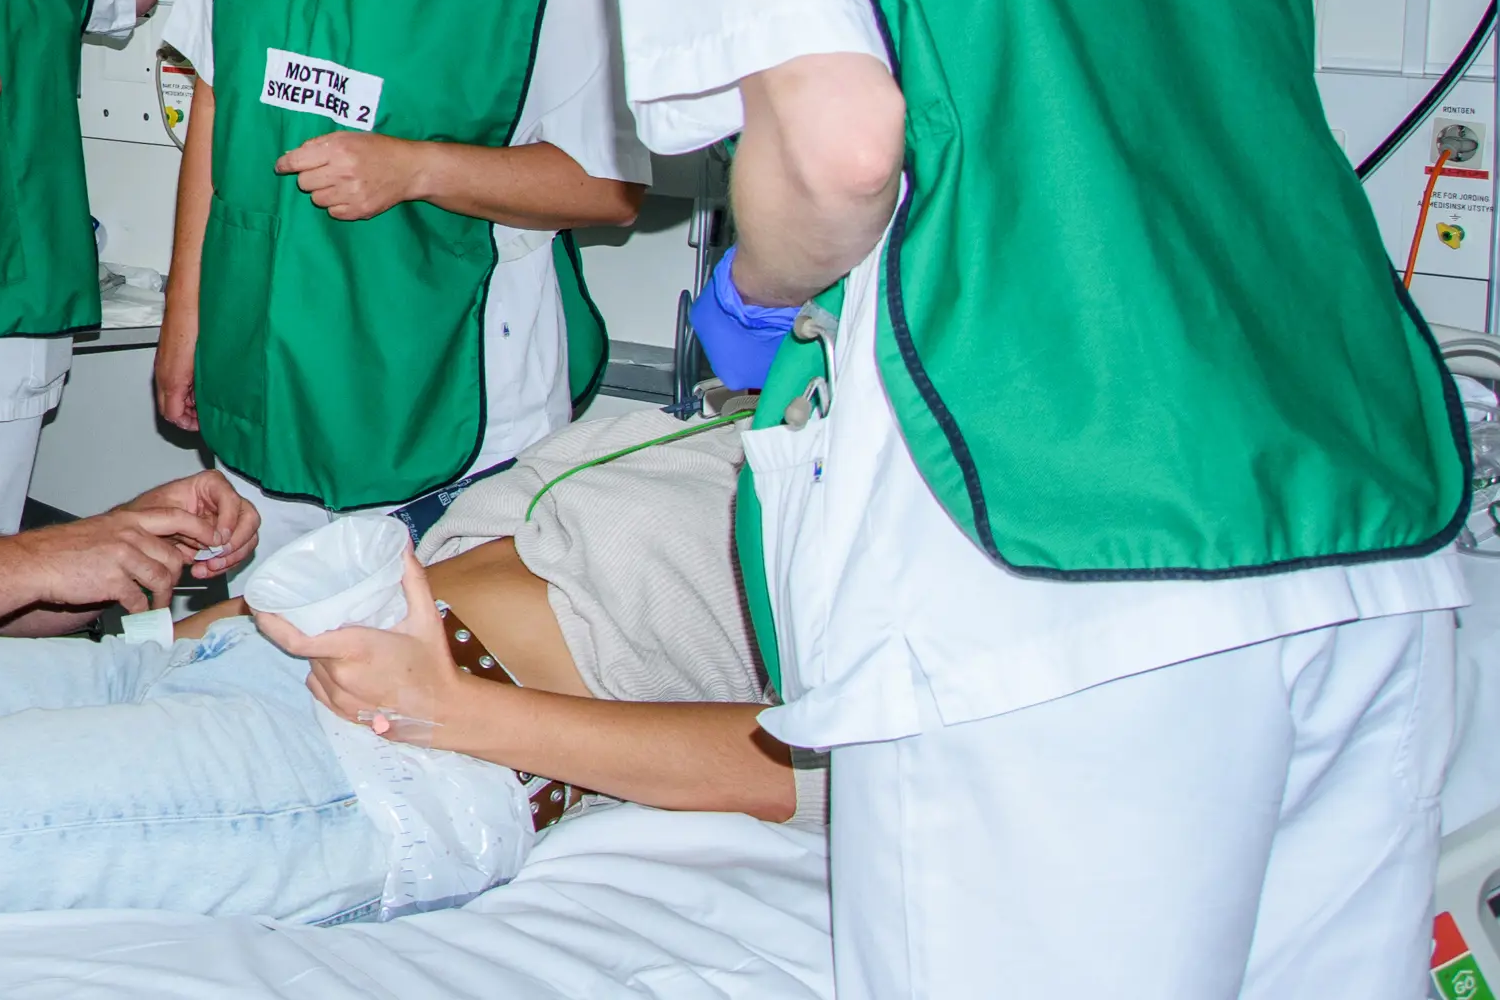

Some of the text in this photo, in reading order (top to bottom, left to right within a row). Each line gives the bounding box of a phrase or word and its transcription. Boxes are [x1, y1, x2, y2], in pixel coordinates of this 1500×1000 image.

[285, 61, 350, 95] MOTTAK
[355, 105, 371, 123] 2
[1443, 192, 1458, 200] FOR
[1459, 194, 1490, 203] JORDING
[1467, 205, 1495, 213] UTSTYR
[1454, 975, 1475, 994] GO
